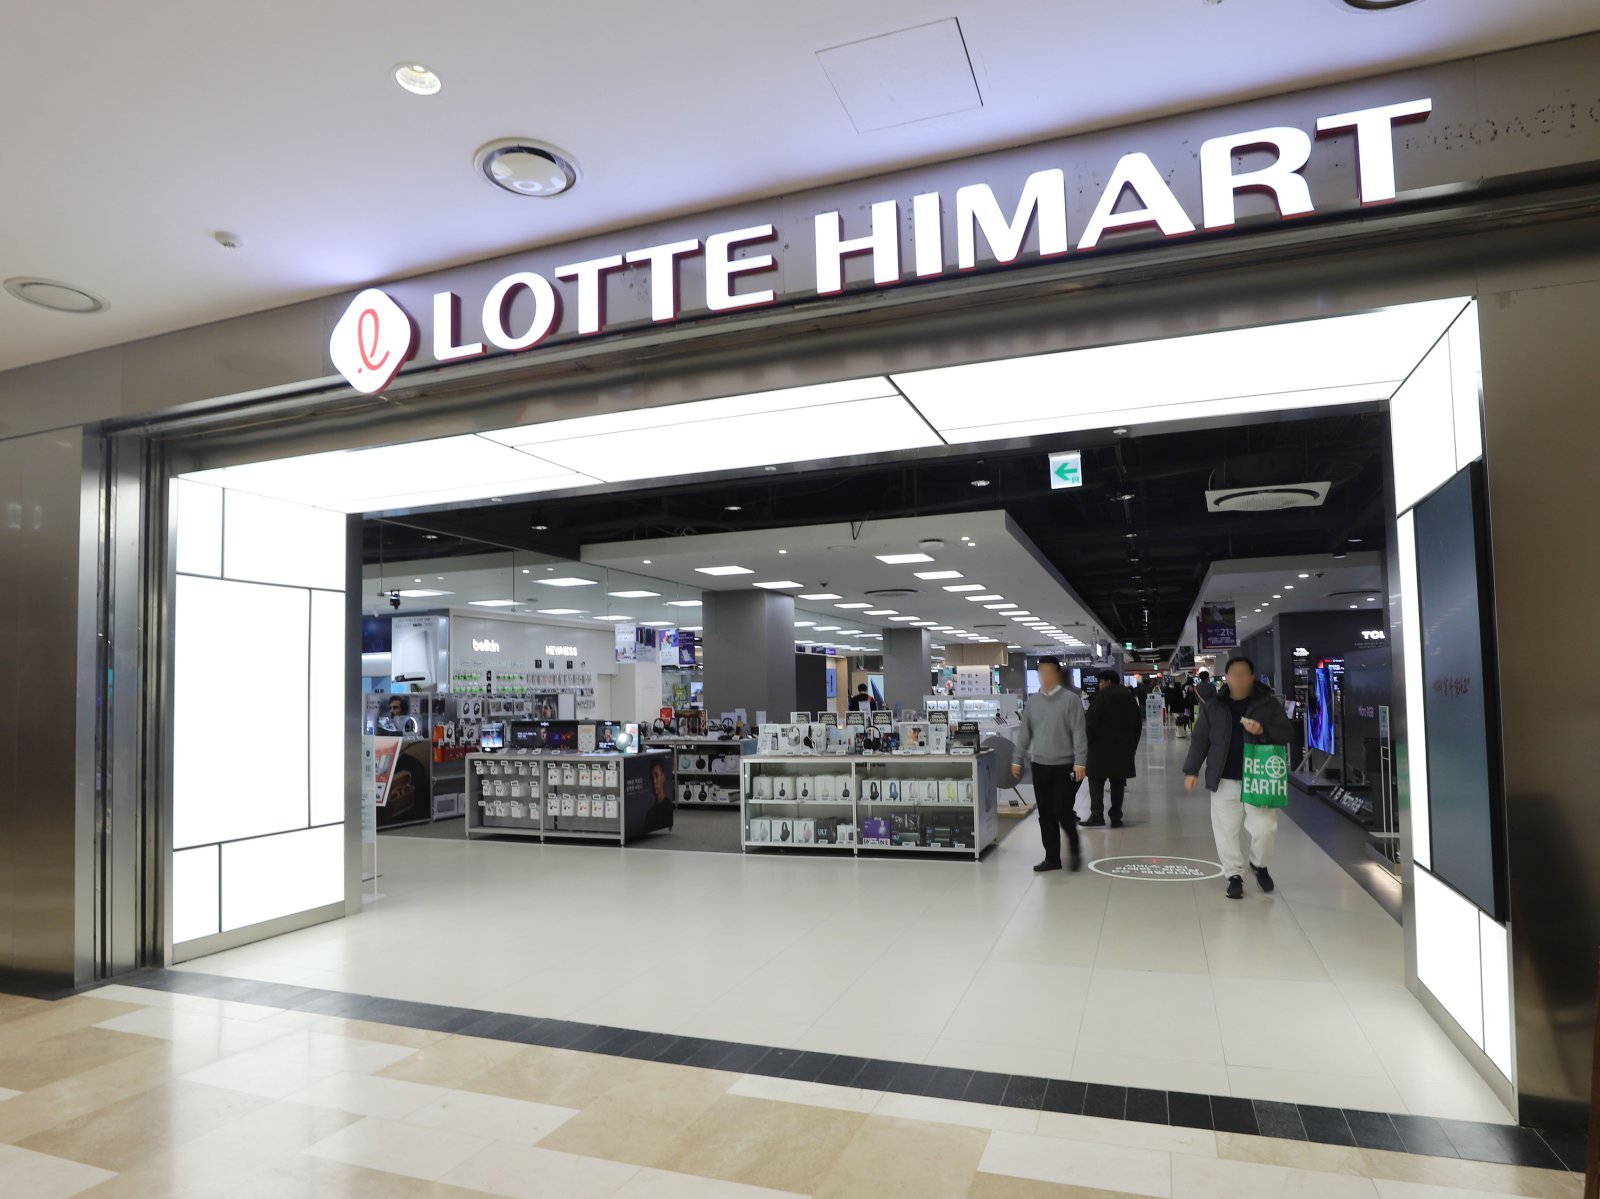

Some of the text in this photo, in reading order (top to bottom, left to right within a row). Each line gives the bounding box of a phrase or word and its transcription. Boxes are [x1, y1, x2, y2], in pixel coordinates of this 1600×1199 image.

[432, 98, 1433, 362] LOTTE HIMART
[472, 638, 500, 653] belkin
[545, 645, 578, 657] NEWNESS
[1244, 757, 1264, 774] RE:
[1243, 777, 1287, 796] EARTH
